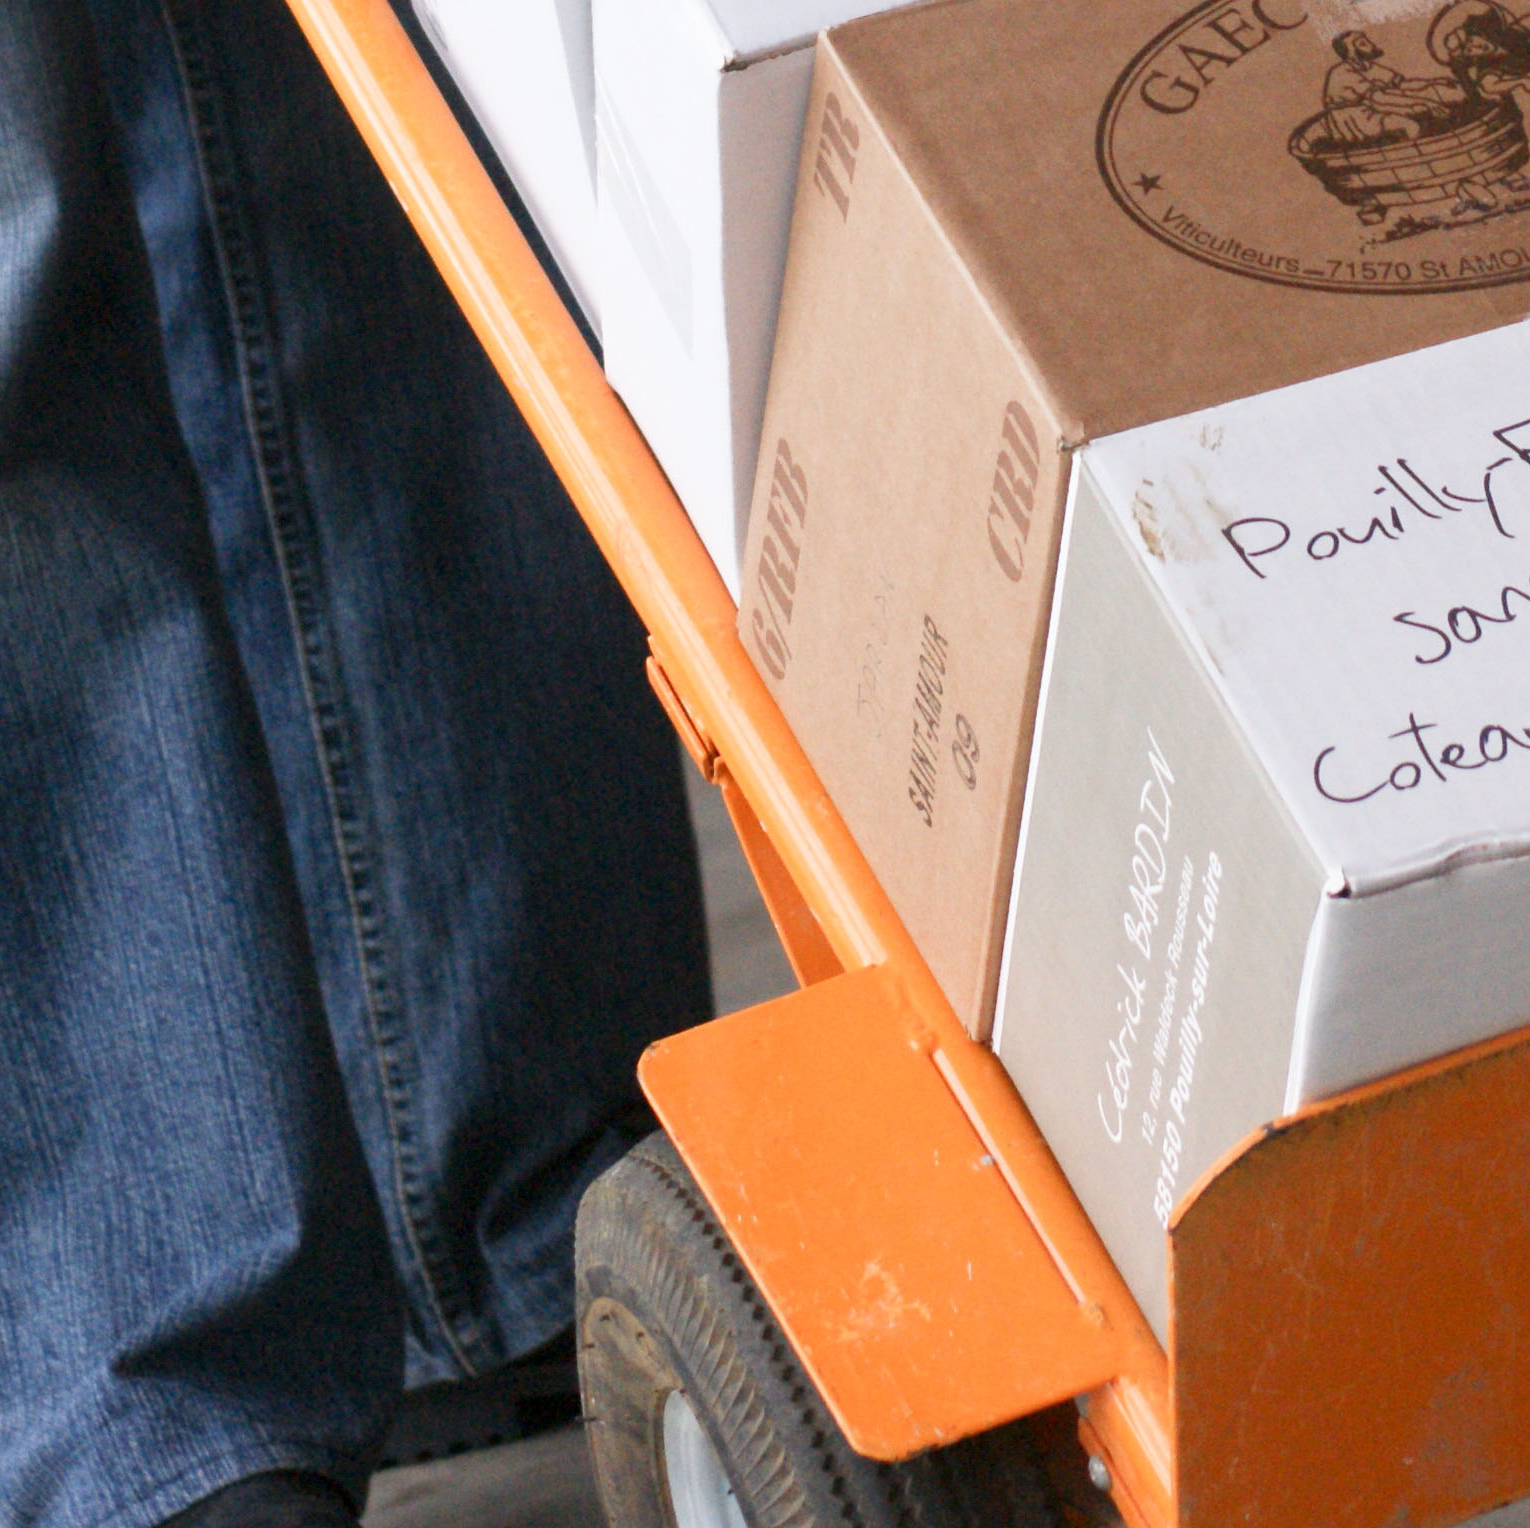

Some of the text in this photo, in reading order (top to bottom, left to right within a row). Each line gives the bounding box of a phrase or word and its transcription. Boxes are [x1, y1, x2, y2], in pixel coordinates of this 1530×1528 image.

[813, 88, 862, 224] TR
[1419, 259, 1448, 280] St
[986, 398, 1042, 584] CRD
[908, 613, 949, 828] SAINT-AMOUR
[952, 713, 980, 791] 09
[1097, 725, 1175, 1145] Cédrick BARDIN
[1149, 1068, 1163, 1110] rue
[1154, 850, 1224, 1231] 58150 Pouilly-sur-Loire
